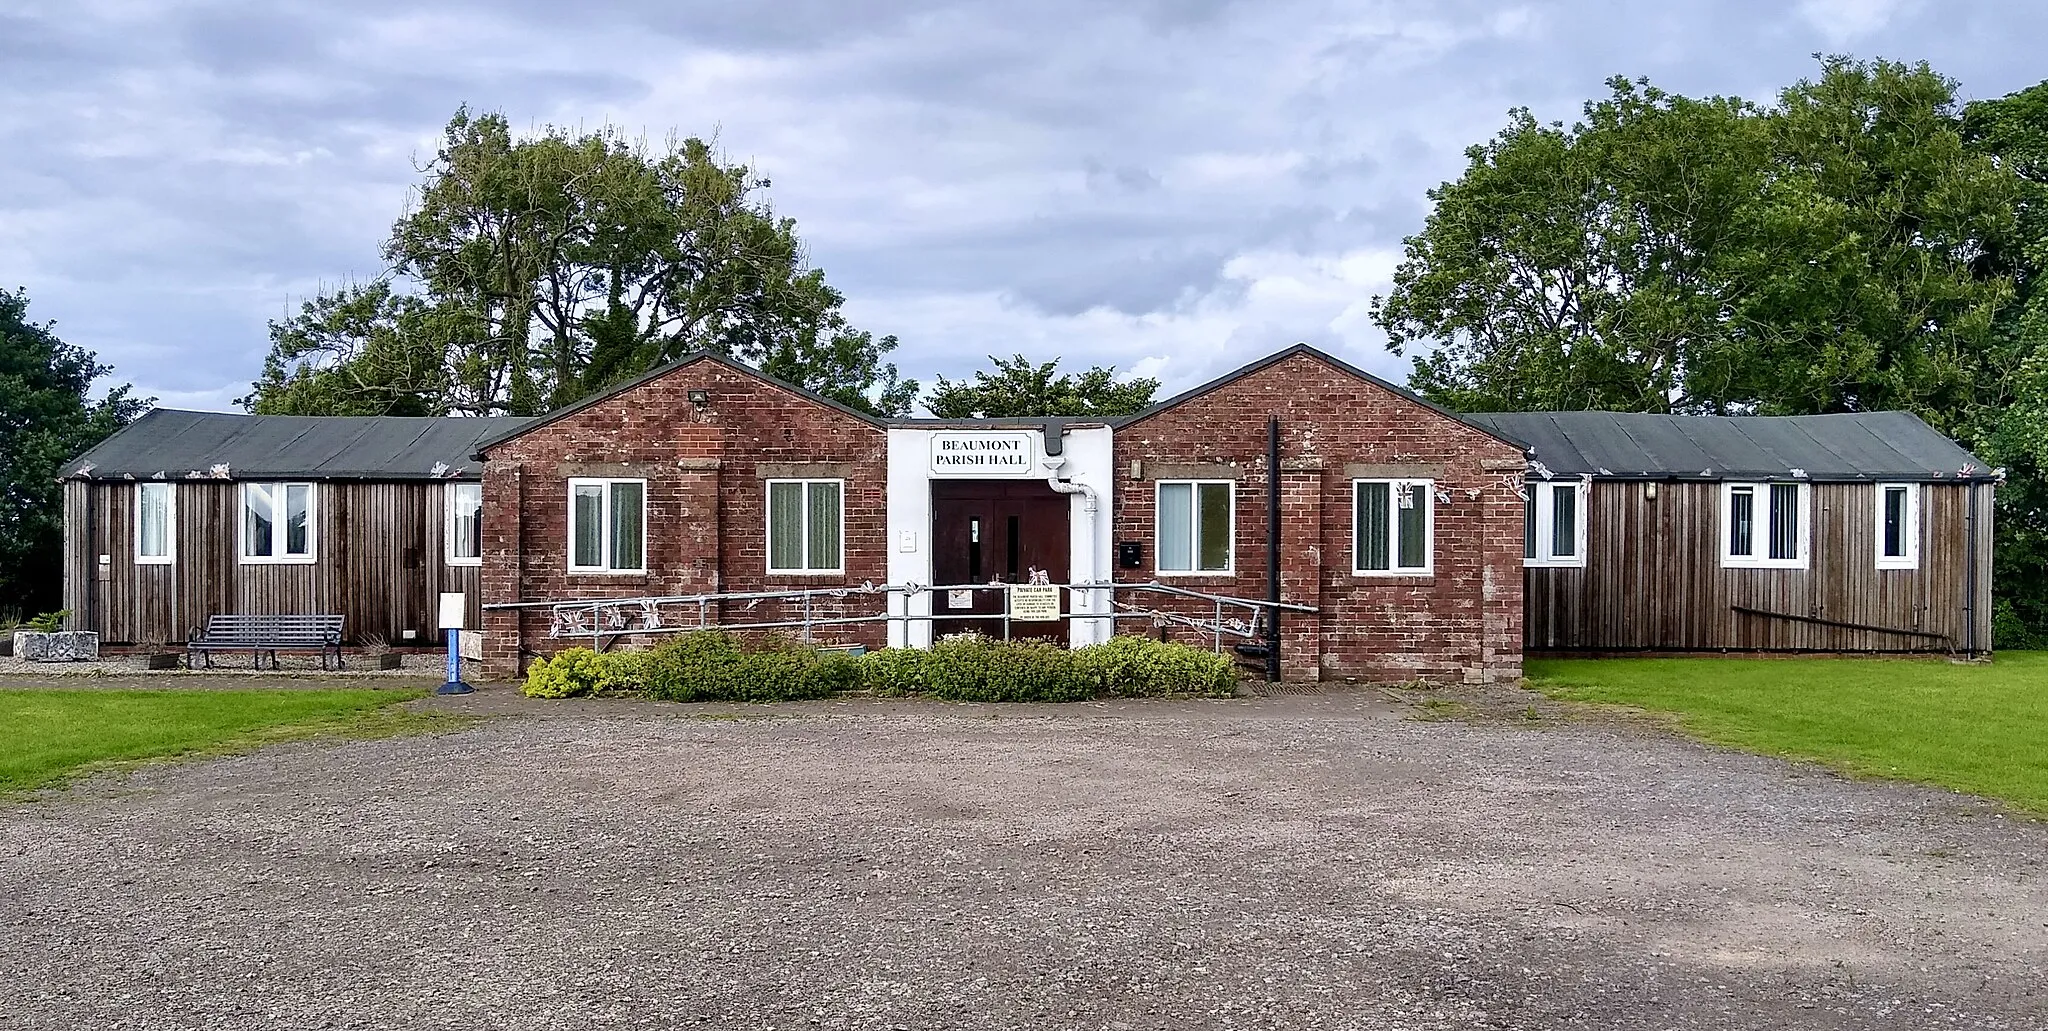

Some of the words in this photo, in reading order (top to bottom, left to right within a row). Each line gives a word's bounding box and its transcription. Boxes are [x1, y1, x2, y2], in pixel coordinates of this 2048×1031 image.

[942, 440, 1021, 450] BEAUMONT
[936, 455, 984, 465] PARISH
[989, 455, 1027, 465] HALL
